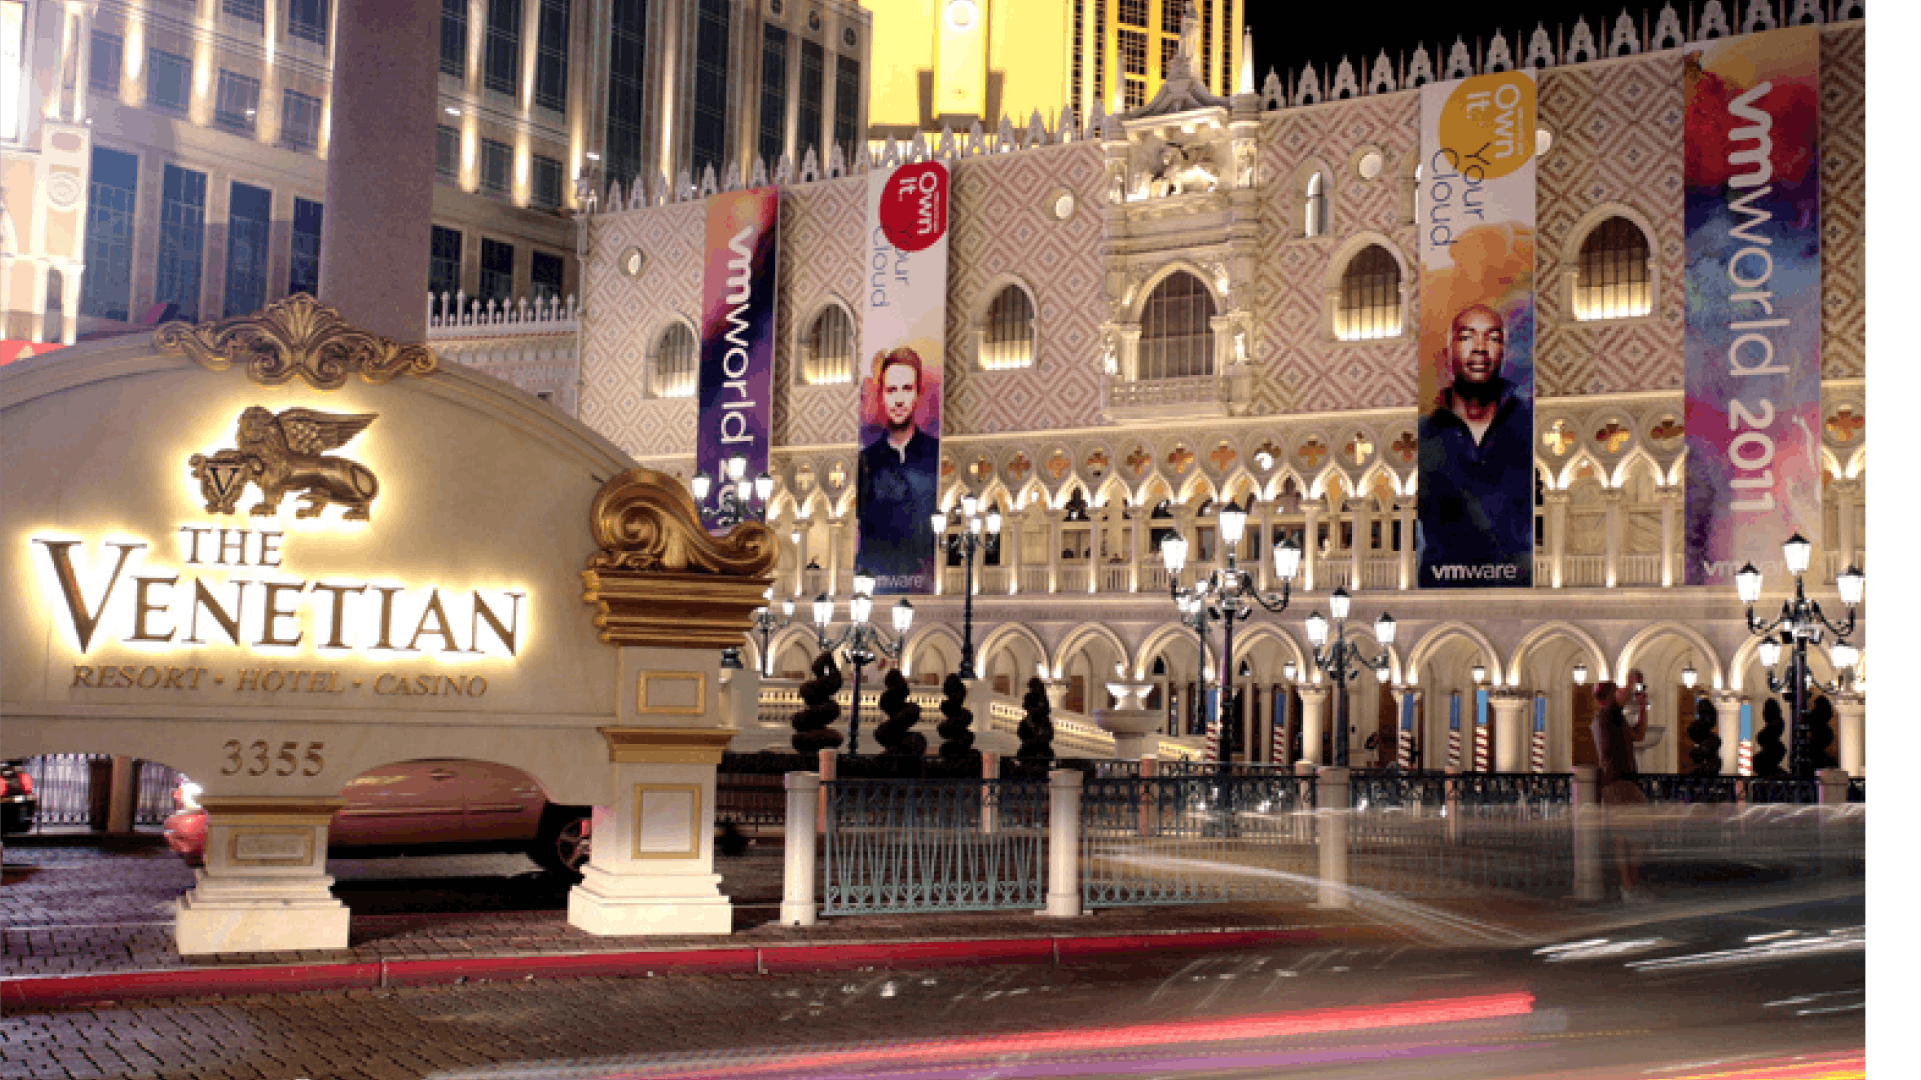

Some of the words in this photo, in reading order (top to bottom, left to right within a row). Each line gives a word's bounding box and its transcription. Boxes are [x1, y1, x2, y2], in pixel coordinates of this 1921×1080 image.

[1494, 83, 1521, 158] Own
[917, 171, 937, 235] Own
[1462, 141, 1492, 221] Your
[894, 221, 915, 286] Your
[1728, 81, 1790, 377] vmworld
[720, 225, 756, 446] vmworld
[1729, 400, 1775, 511] 2011
[180, 526, 284, 567] THE
[1430, 564, 1517, 579] vmware
[32, 538, 526, 656] VENETIAN
[69, 664, 208, 691] RESORT
[235, 667, 344, 695] HOTEL
[373, 672, 489, 698] CASINO
[220, 738, 325, 777] 3355
